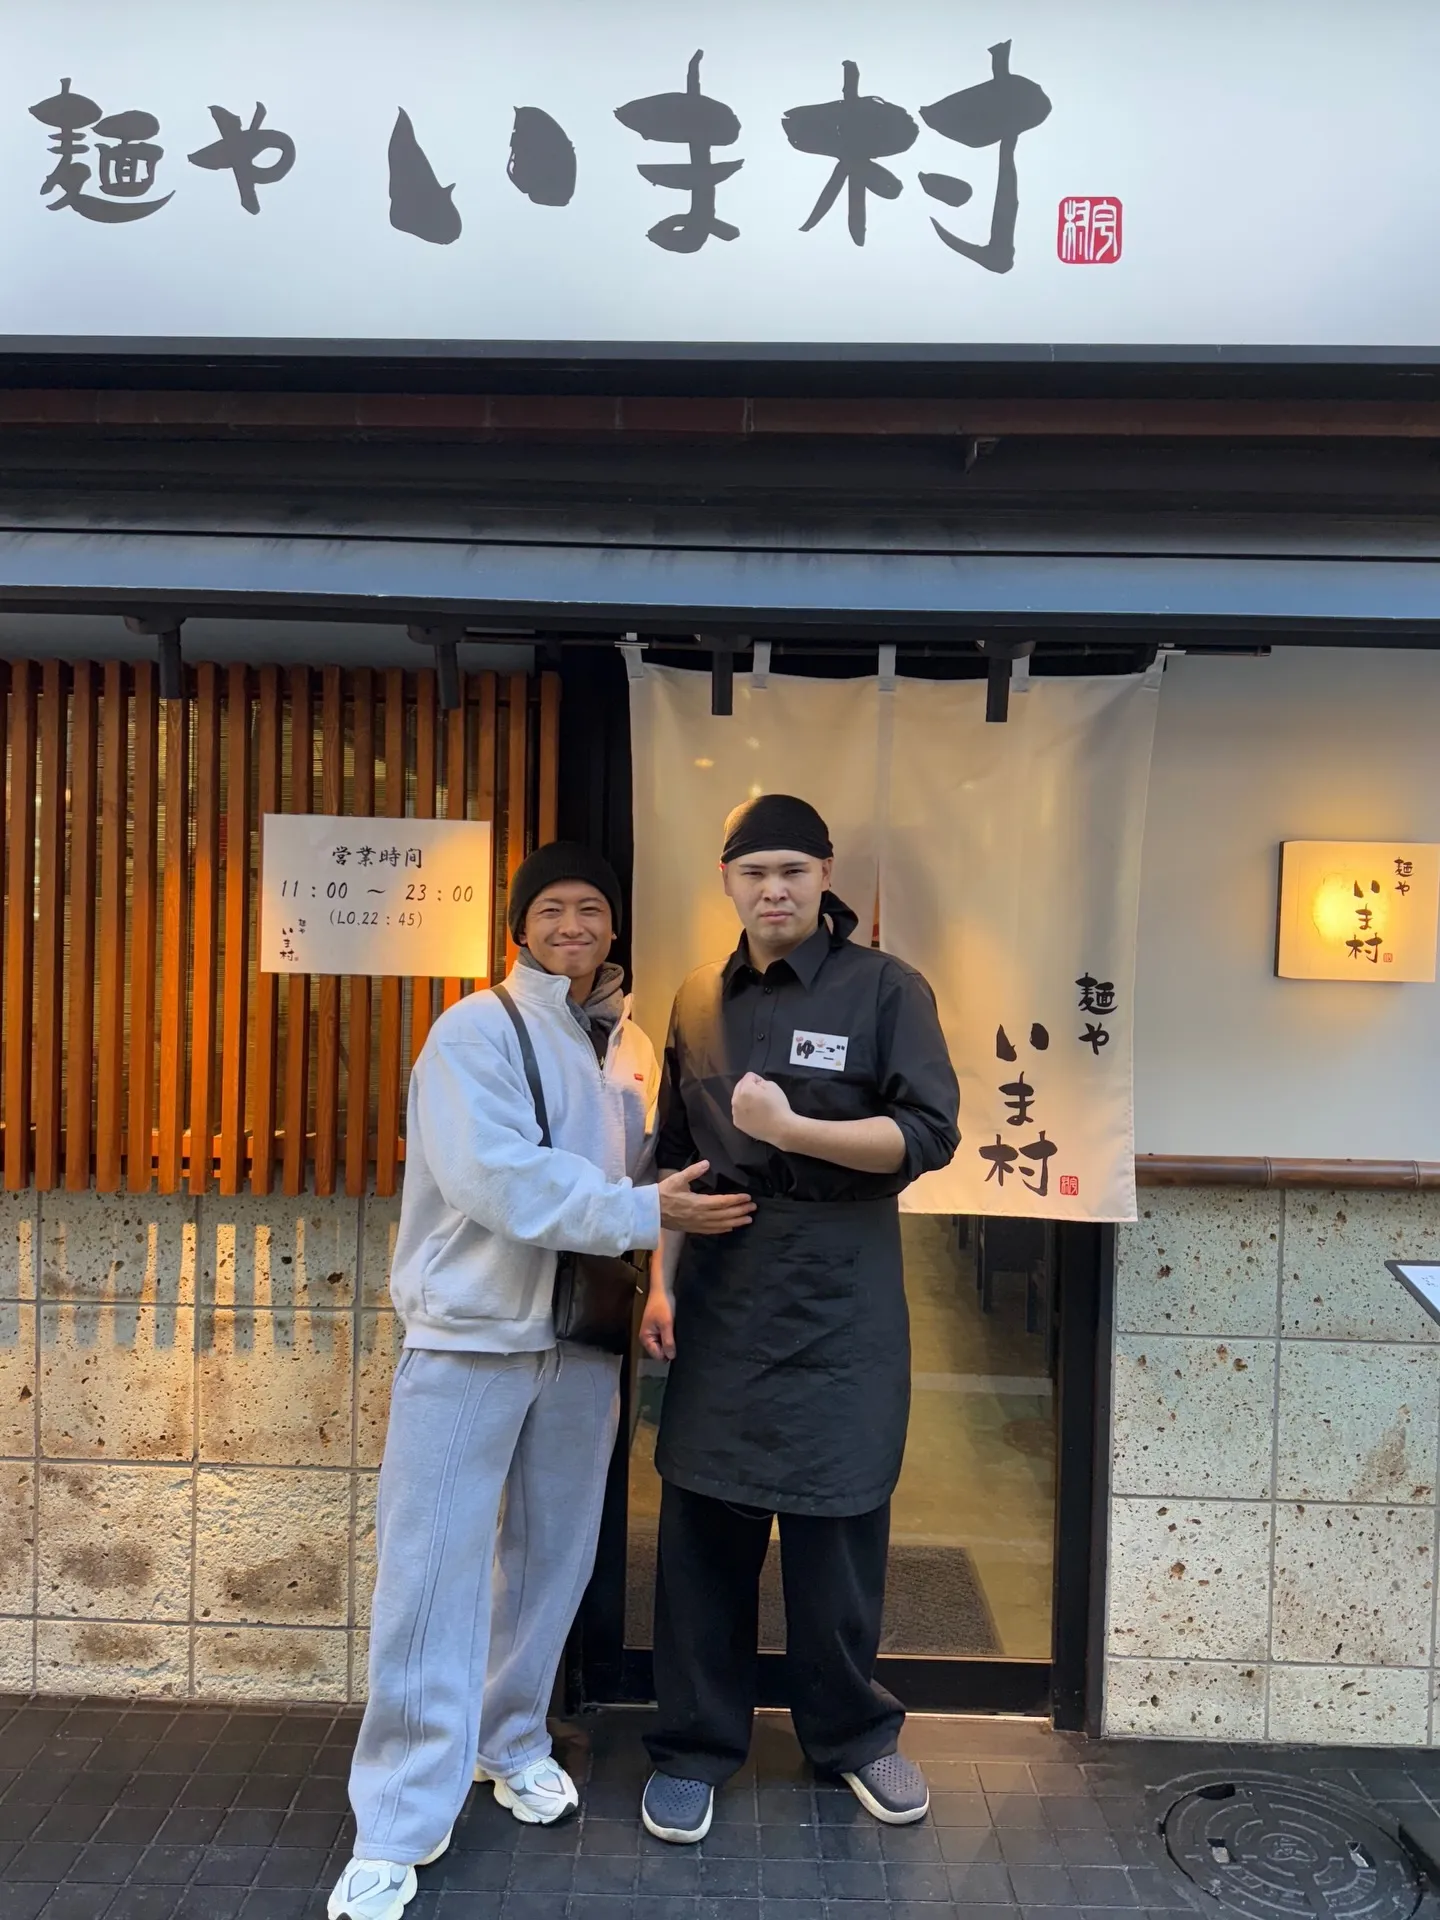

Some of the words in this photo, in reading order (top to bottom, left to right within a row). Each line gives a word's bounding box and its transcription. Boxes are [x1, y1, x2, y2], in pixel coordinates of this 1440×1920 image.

[28, 77, 296, 224] 麺や
[388, 38, 1050, 275] いま村
[332, 845, 423, 869] 営業時間
[1394, 857, 1414, 897] 麺や
[1345, 879, 1383, 964] いま村
[1075, 972, 1118, 1056] 麺や
[978, 1022, 1058, 1197] いま村
